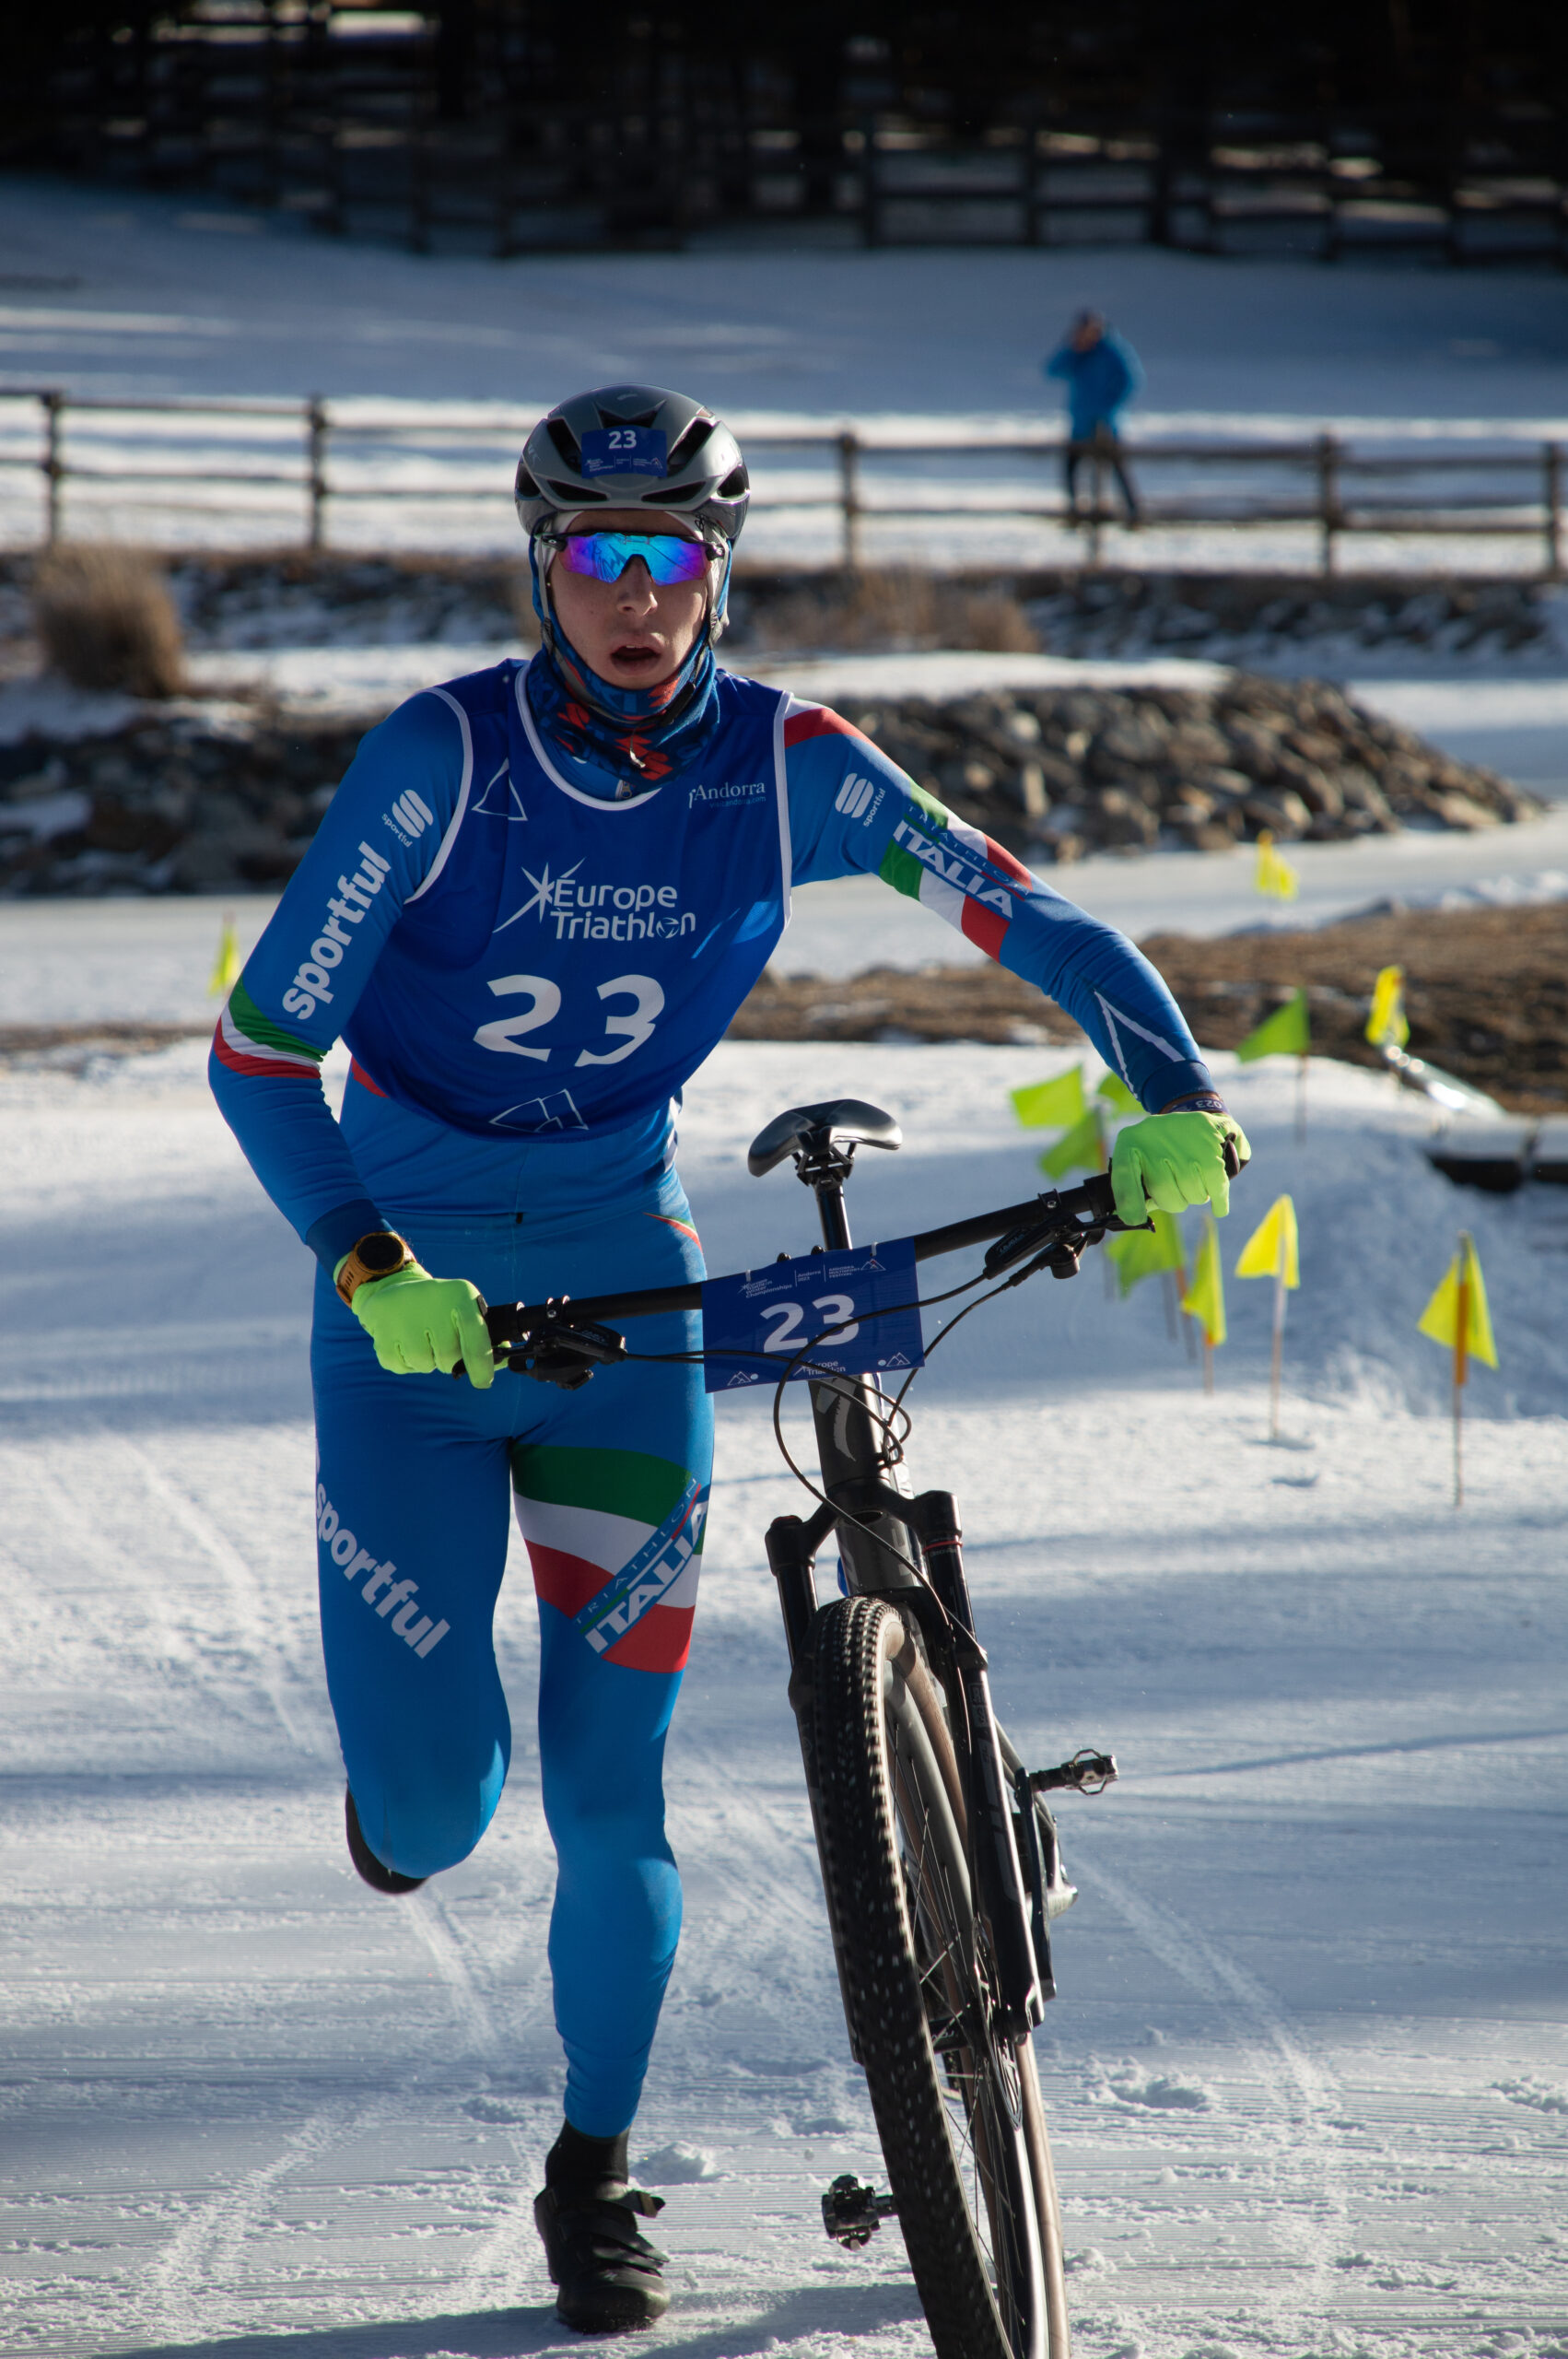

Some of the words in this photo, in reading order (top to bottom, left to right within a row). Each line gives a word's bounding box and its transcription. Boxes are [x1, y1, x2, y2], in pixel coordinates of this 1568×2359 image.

[608, 429, 638, 451] 23
[692, 781, 766, 802] Andorra
[862, 787, 886, 827] sportful
[380, 813, 414, 849] sportful
[892, 819, 1013, 920] ITALIA
[553, 878, 678, 912] Europe
[281, 839, 392, 1021] sportful
[549, 910, 696, 942] Triathlon
[472, 973, 666, 1068] 23
[759, 1294, 860, 1354] 23
[806, 1360, 839, 1370] rope
[316, 1483, 451, 1660] sportful
[574, 1477, 698, 1625] TRIATHLON
[584, 1500, 708, 1654] ITALIA
